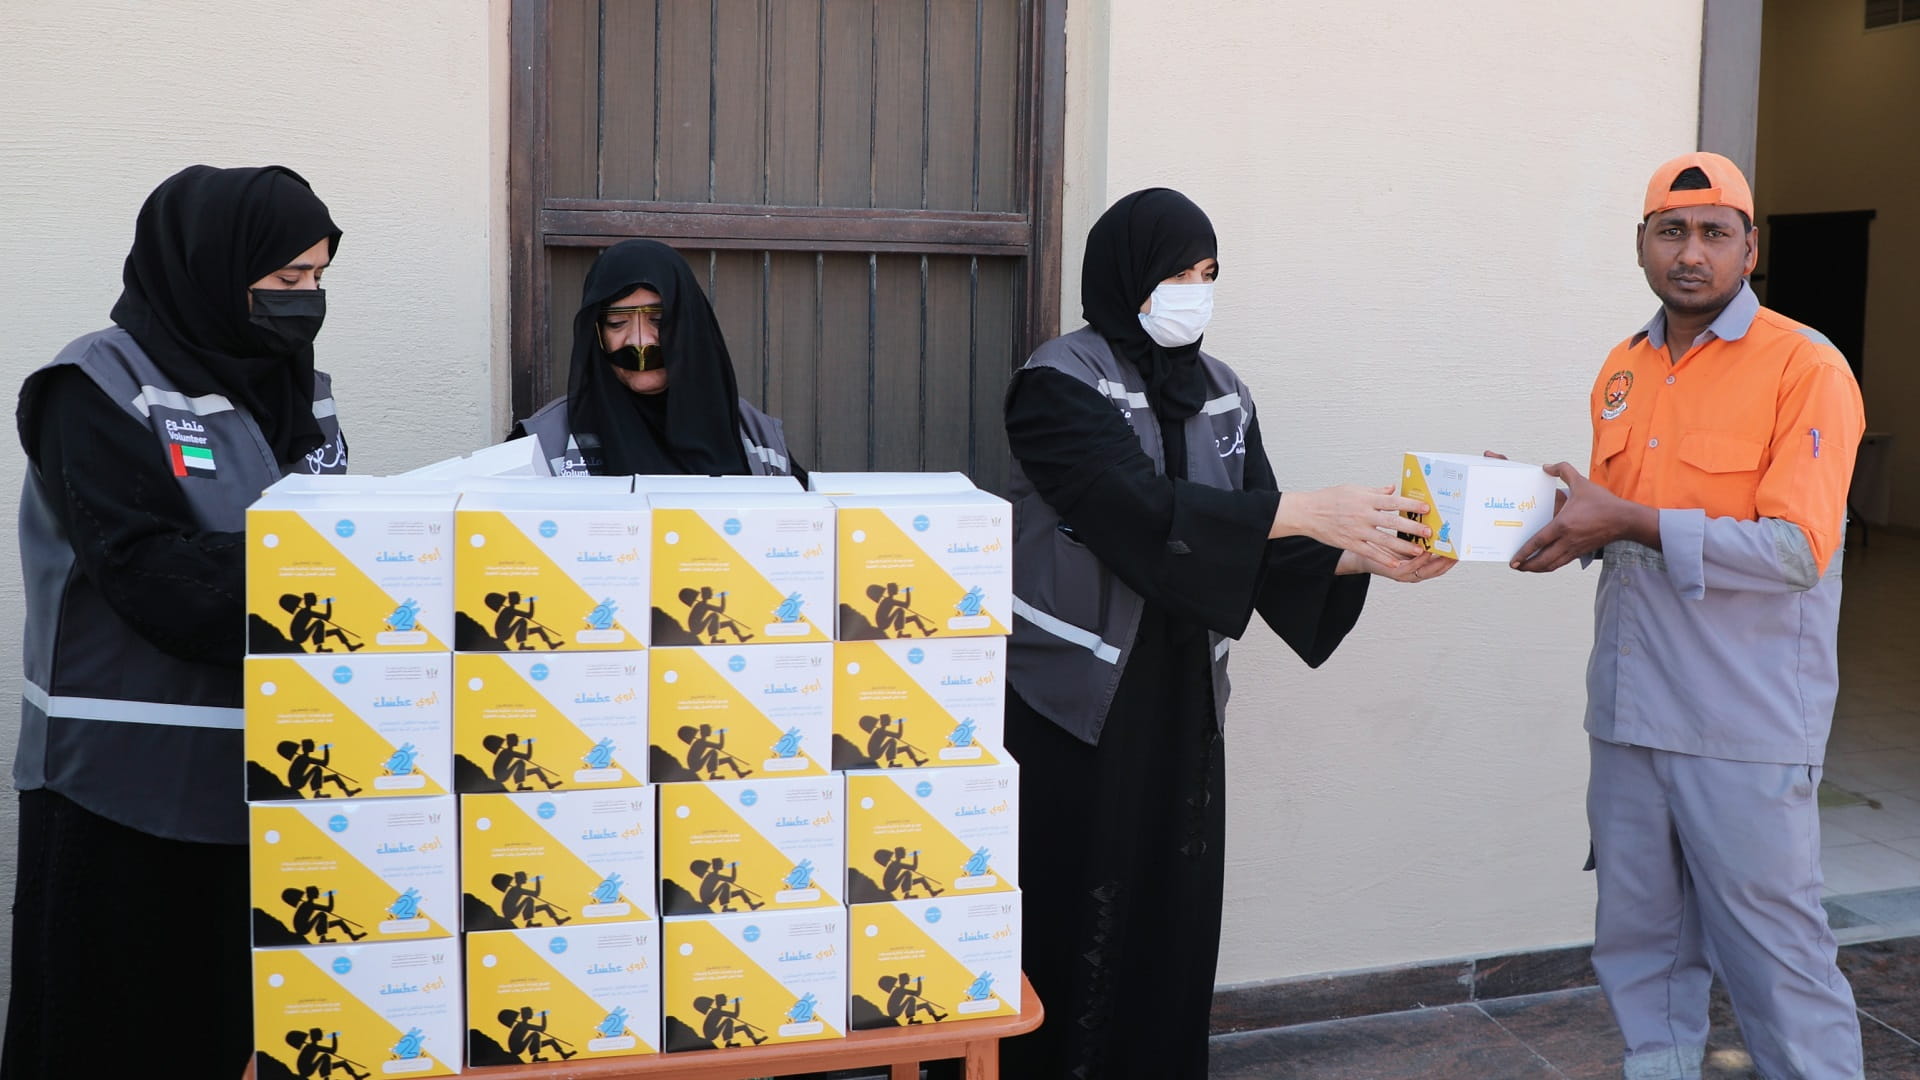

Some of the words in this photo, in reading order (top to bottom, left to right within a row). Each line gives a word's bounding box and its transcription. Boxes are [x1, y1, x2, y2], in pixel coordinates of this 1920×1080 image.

[165, 419, 204, 432] متطوع
[168, 430, 207, 444] Volunteer
[781, 598, 797, 621] 2
[963, 592, 978, 615] 2
[394, 605, 413, 630] 2
[593, 605, 611, 628] 2
[779, 734, 796, 756] 2
[954, 724, 970, 746] 2
[392, 750, 410, 774] 2
[591, 744, 609, 768] 2
[969, 853, 985, 875] 2
[791, 865, 807, 888] 2
[599, 879, 616, 903] 2
[396, 894, 415, 918] 2
[972, 977, 988, 999] 2
[794, 999, 811, 1022] 2
[604, 1013, 622, 1036] 2
[399, 1034, 418, 1058] 2
